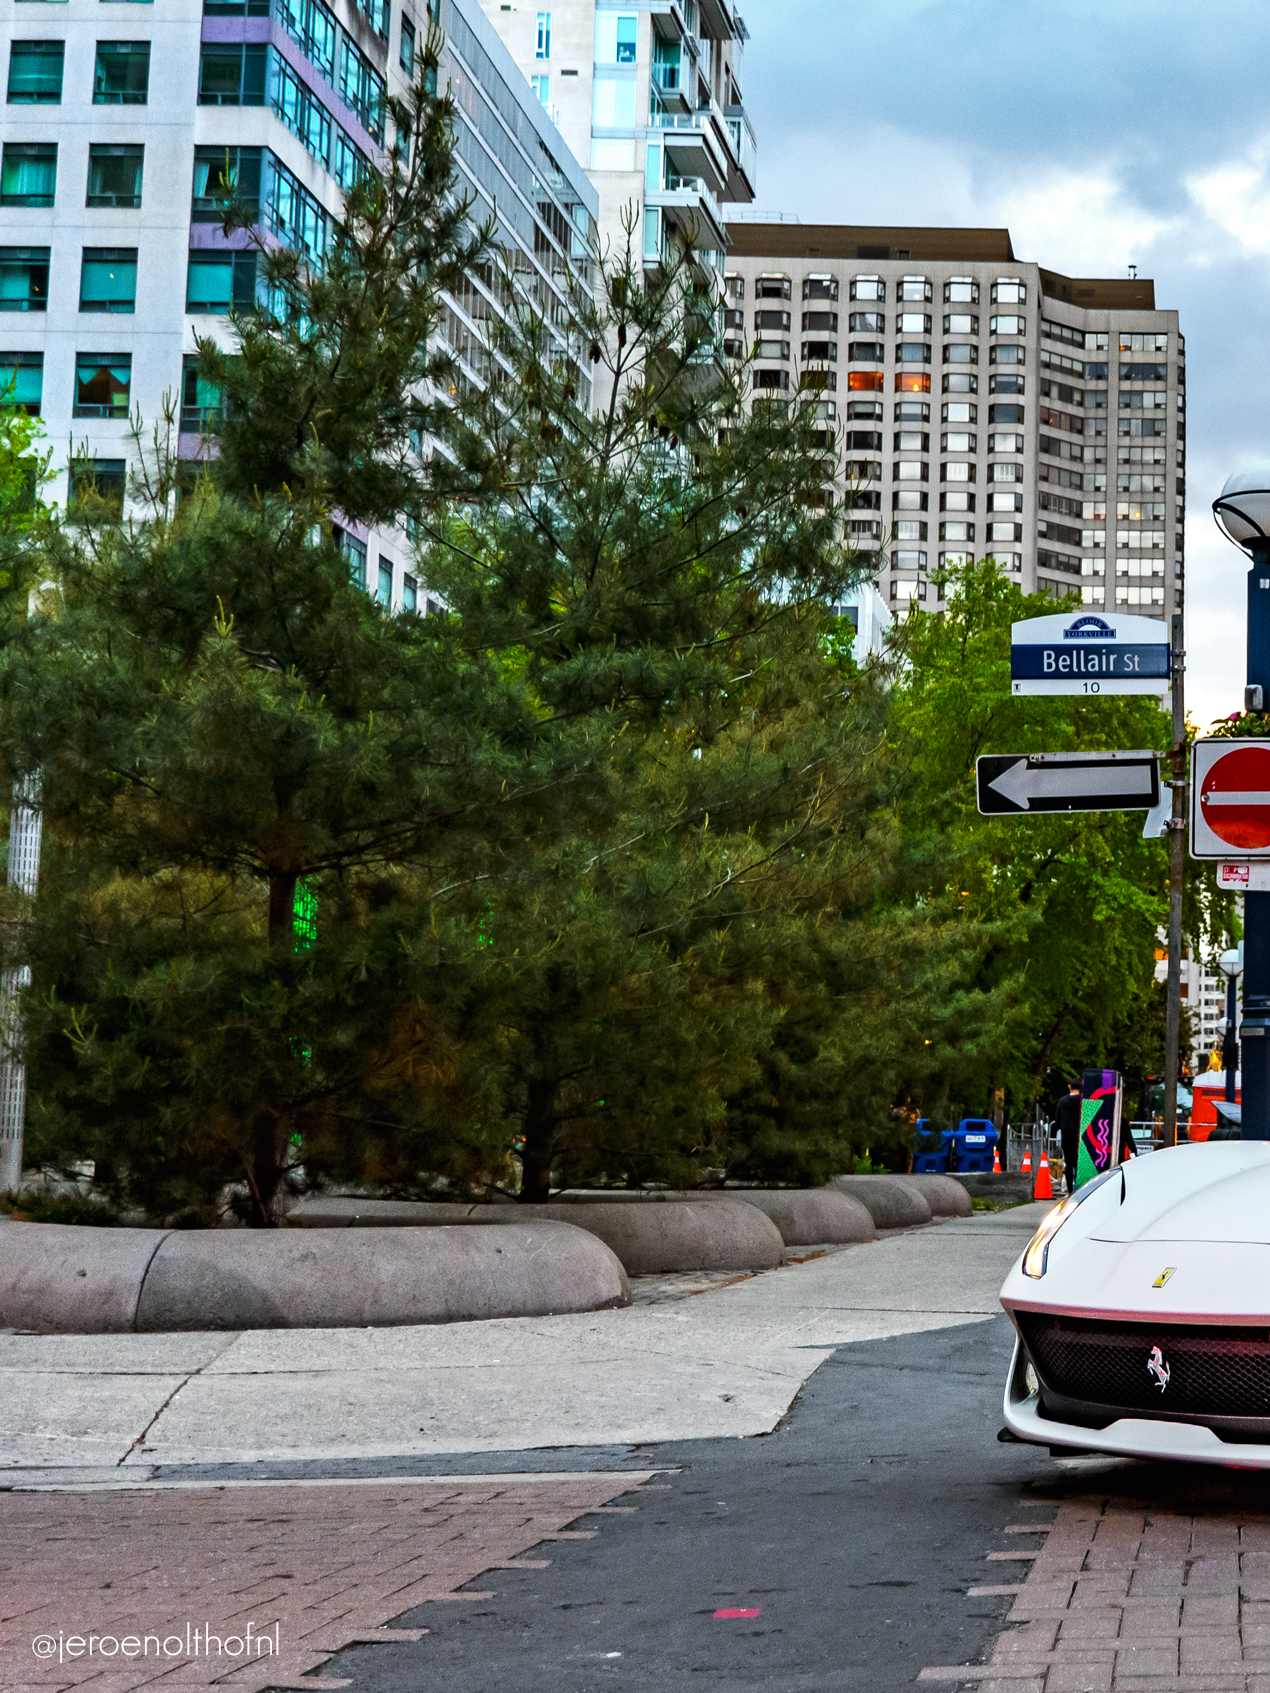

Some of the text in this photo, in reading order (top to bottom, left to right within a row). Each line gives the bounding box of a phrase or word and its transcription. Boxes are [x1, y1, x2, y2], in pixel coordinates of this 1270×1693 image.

[1076, 618, 1103, 628] BLOOR
[1043, 649, 1140, 672] Bellair St
[1083, 682, 1100, 694] 10
